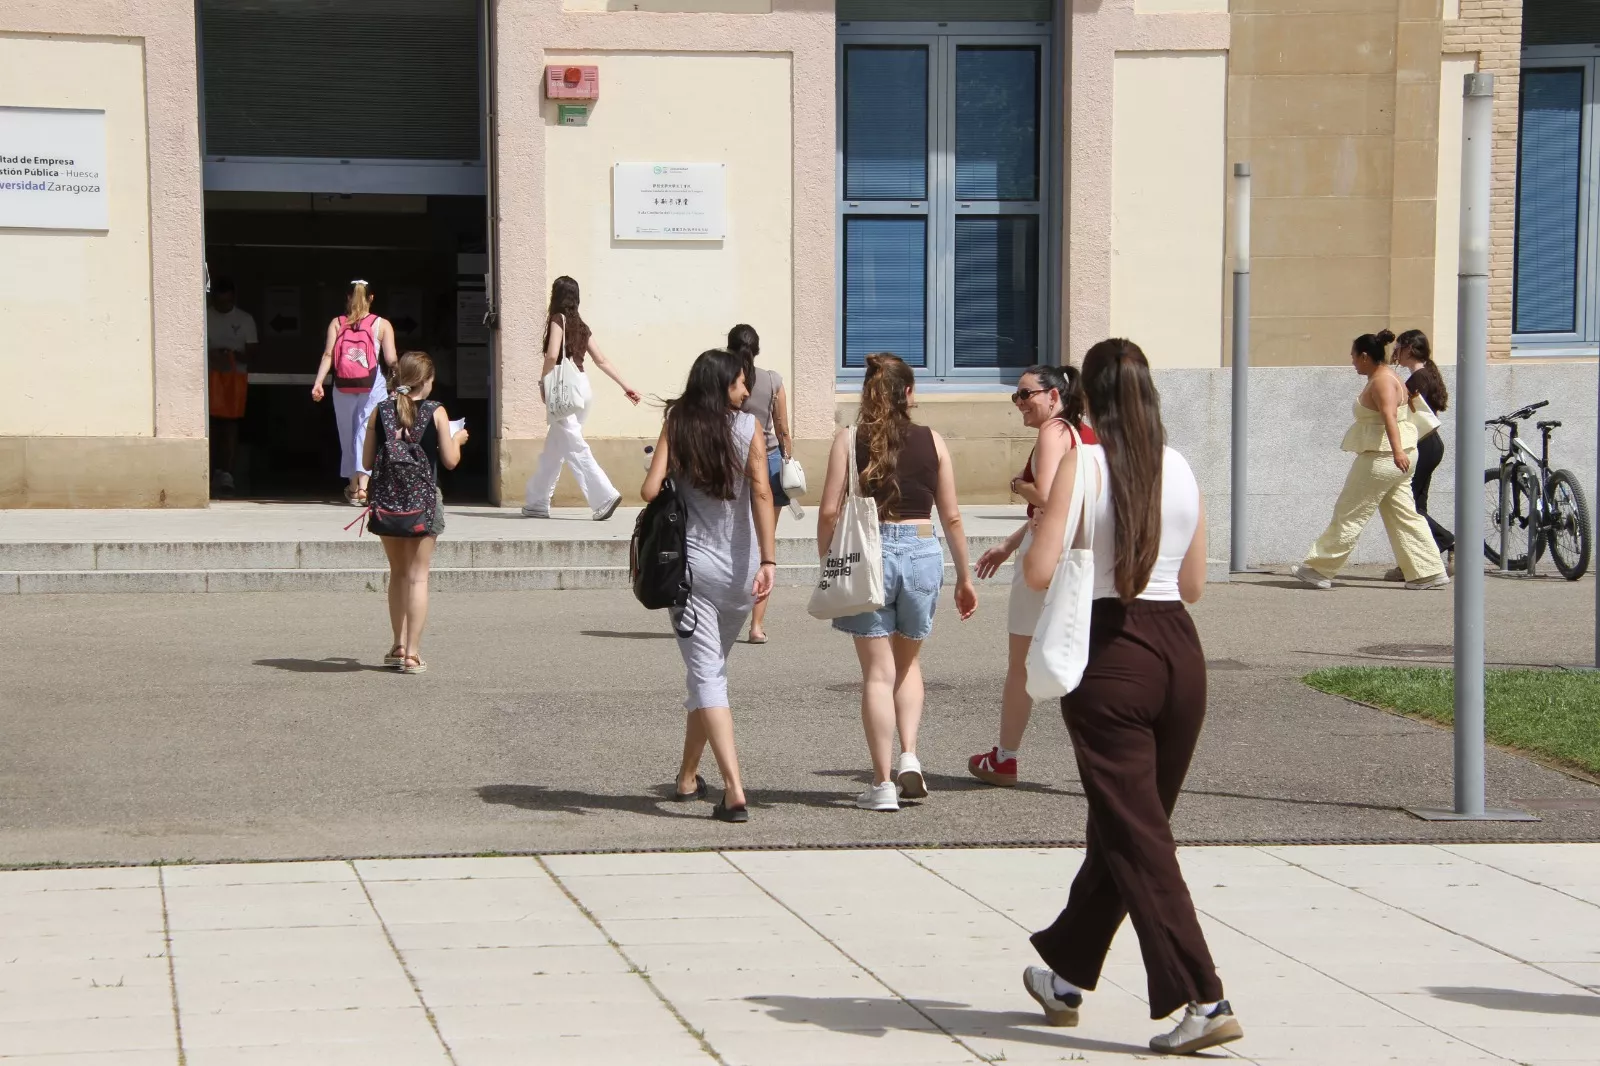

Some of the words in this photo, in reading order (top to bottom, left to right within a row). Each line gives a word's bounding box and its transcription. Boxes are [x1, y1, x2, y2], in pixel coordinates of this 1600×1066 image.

[20, 156, 32, 164] de
[34, 157, 74, 166] Empresa
[24, 168, 59, 177] Pública
[66, 170, 98, 178] Huesca
[47, 182, 100, 194] Zaragoza
[845, 552, 861, 563] Hill
